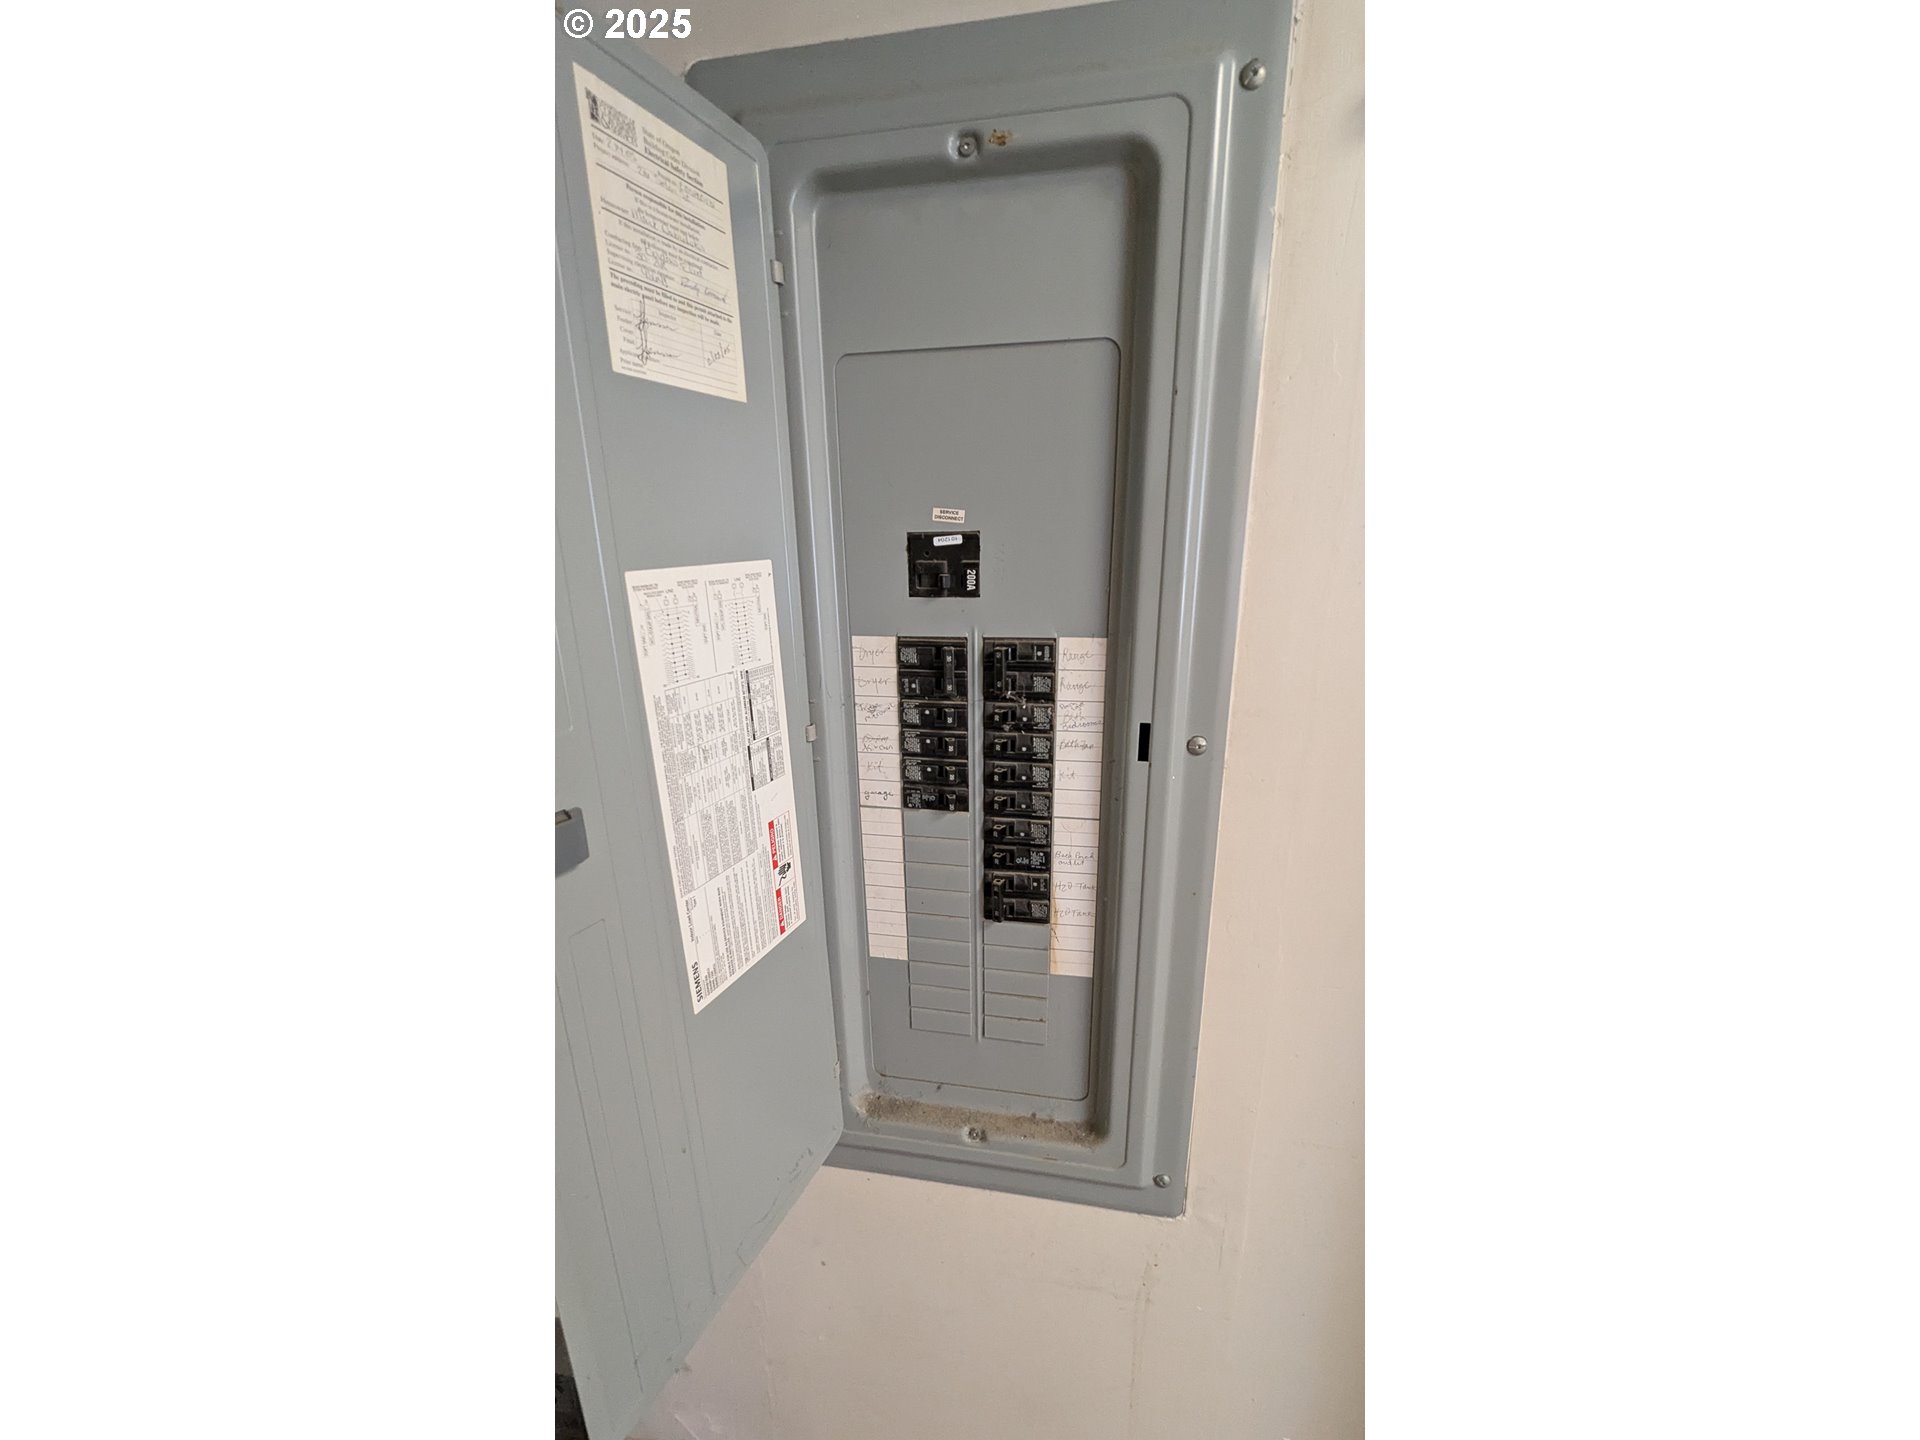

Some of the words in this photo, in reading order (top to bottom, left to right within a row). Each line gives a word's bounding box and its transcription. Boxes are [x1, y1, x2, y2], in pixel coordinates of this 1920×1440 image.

[966, 569, 977, 591] 200A
[769, 828, 777, 854] PELIGRO
[776, 896, 784, 920] DANGER
[691, 961, 704, 1003] SIEMENS
